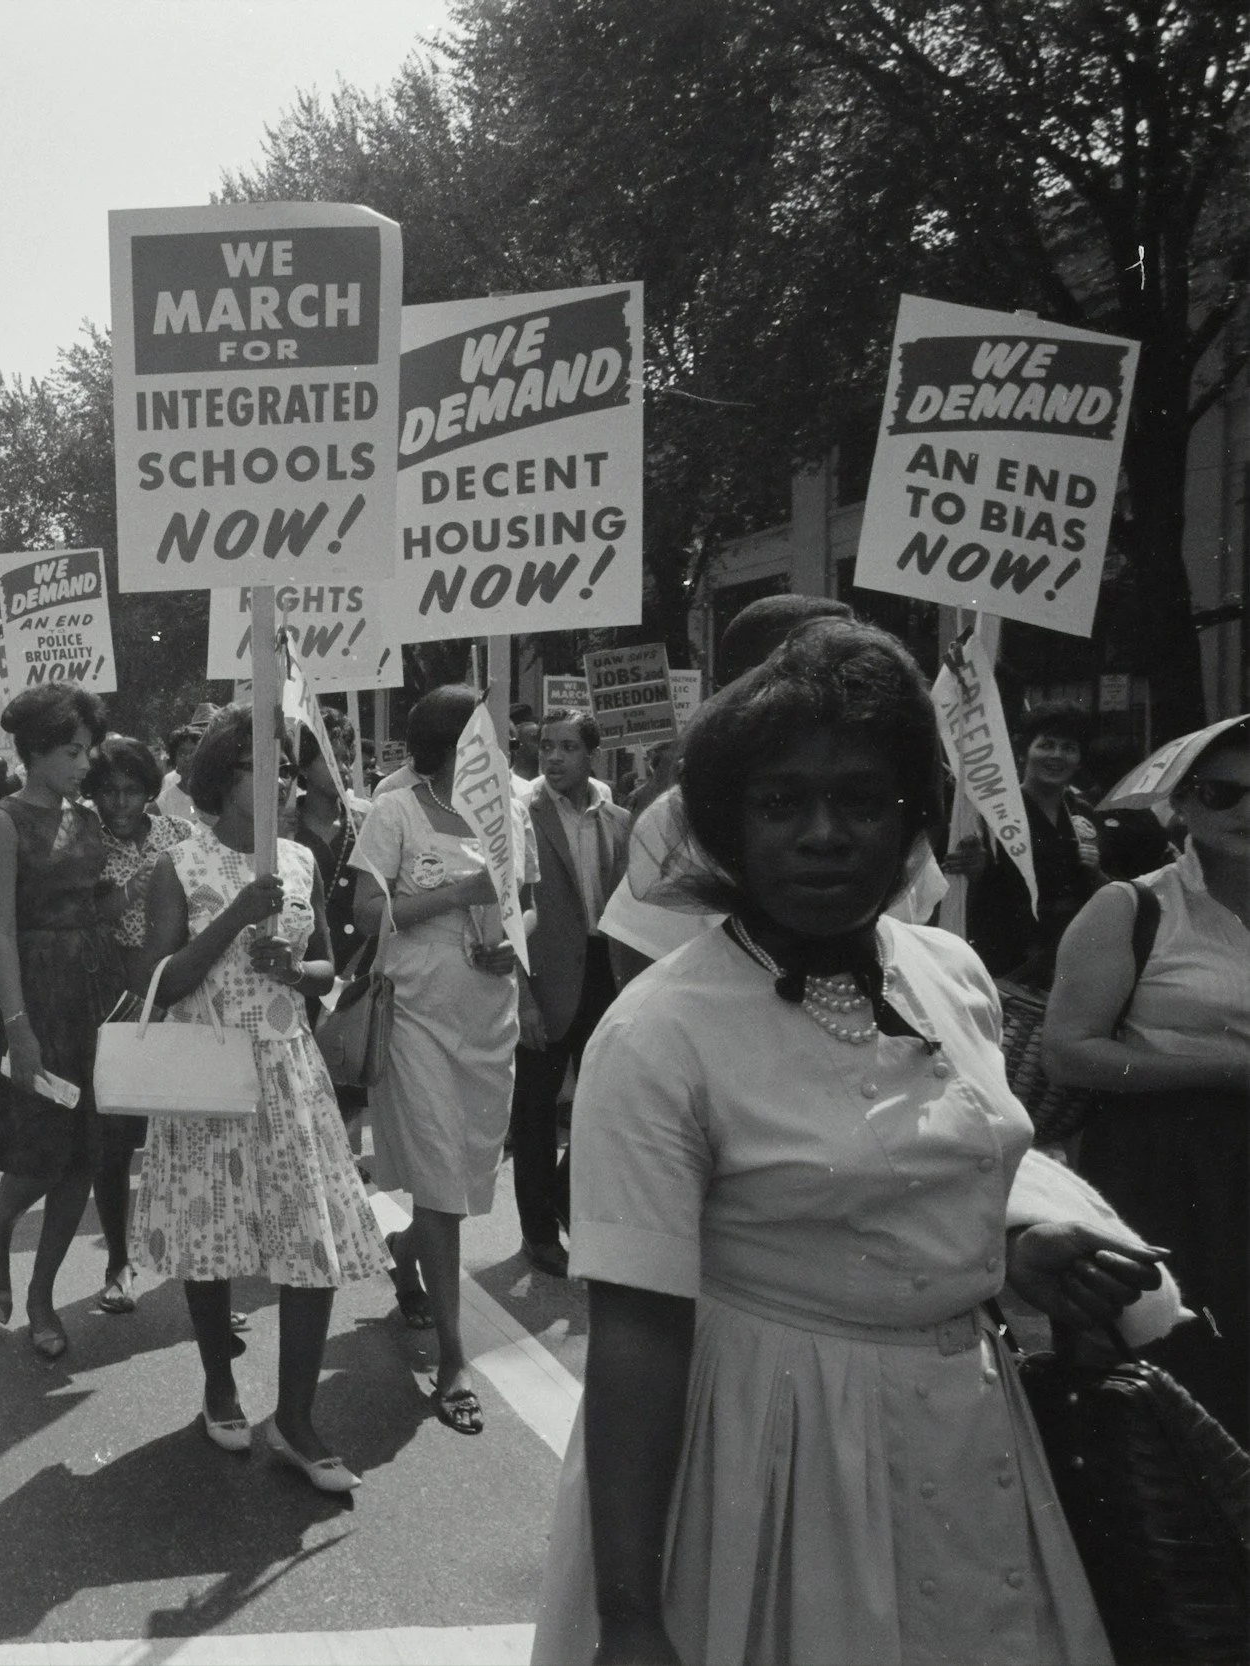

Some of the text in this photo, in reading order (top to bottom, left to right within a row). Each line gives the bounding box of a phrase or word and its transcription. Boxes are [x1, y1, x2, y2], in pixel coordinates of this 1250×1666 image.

[221, 240, 293, 278] WE
[153, 283, 360, 335] MARCH
[219, 339, 299, 363] FOR
[460, 317, 550, 384] WE
[971, 340, 1058, 381] WE
[136, 381, 379, 431] INTEGRATED
[399, 347, 623, 456] DEMAND
[905, 384, 1114, 426] DEMAND
[139, 442, 375, 490] SCHOOLS
[422, 452, 609, 505] DECENT
[906, 443, 1097, 509] AN END
[156, 493, 366, 564] NOW!
[403, 506, 627, 561] HOUSING
[905, 485, 1088, 553] TO BIAS
[34, 558, 69, 584] WE
[419, 545, 616, 617] NOW!
[896, 531, 1082, 602] NOW!
[11, 572, 97, 615] DEMAND
[239, 586, 364, 613] RGHTS
[20, 613, 93, 630] AN END
[37, 633, 83, 648] POLICE
[25, 647, 92, 663] BRUTALITY
[26, 655, 105, 685] NOW!
[593, 655, 624, 668] UAW
[551, 690, 590, 699] MARCH
[563, 682, 578, 691] WE
[593, 666, 664, 688] JOBS and
[595, 685, 669, 712] FREEDOM
[626, 718, 672, 733] American
[454, 733, 509, 871] FREEDOM
[992, 803, 1008, 820] IN
